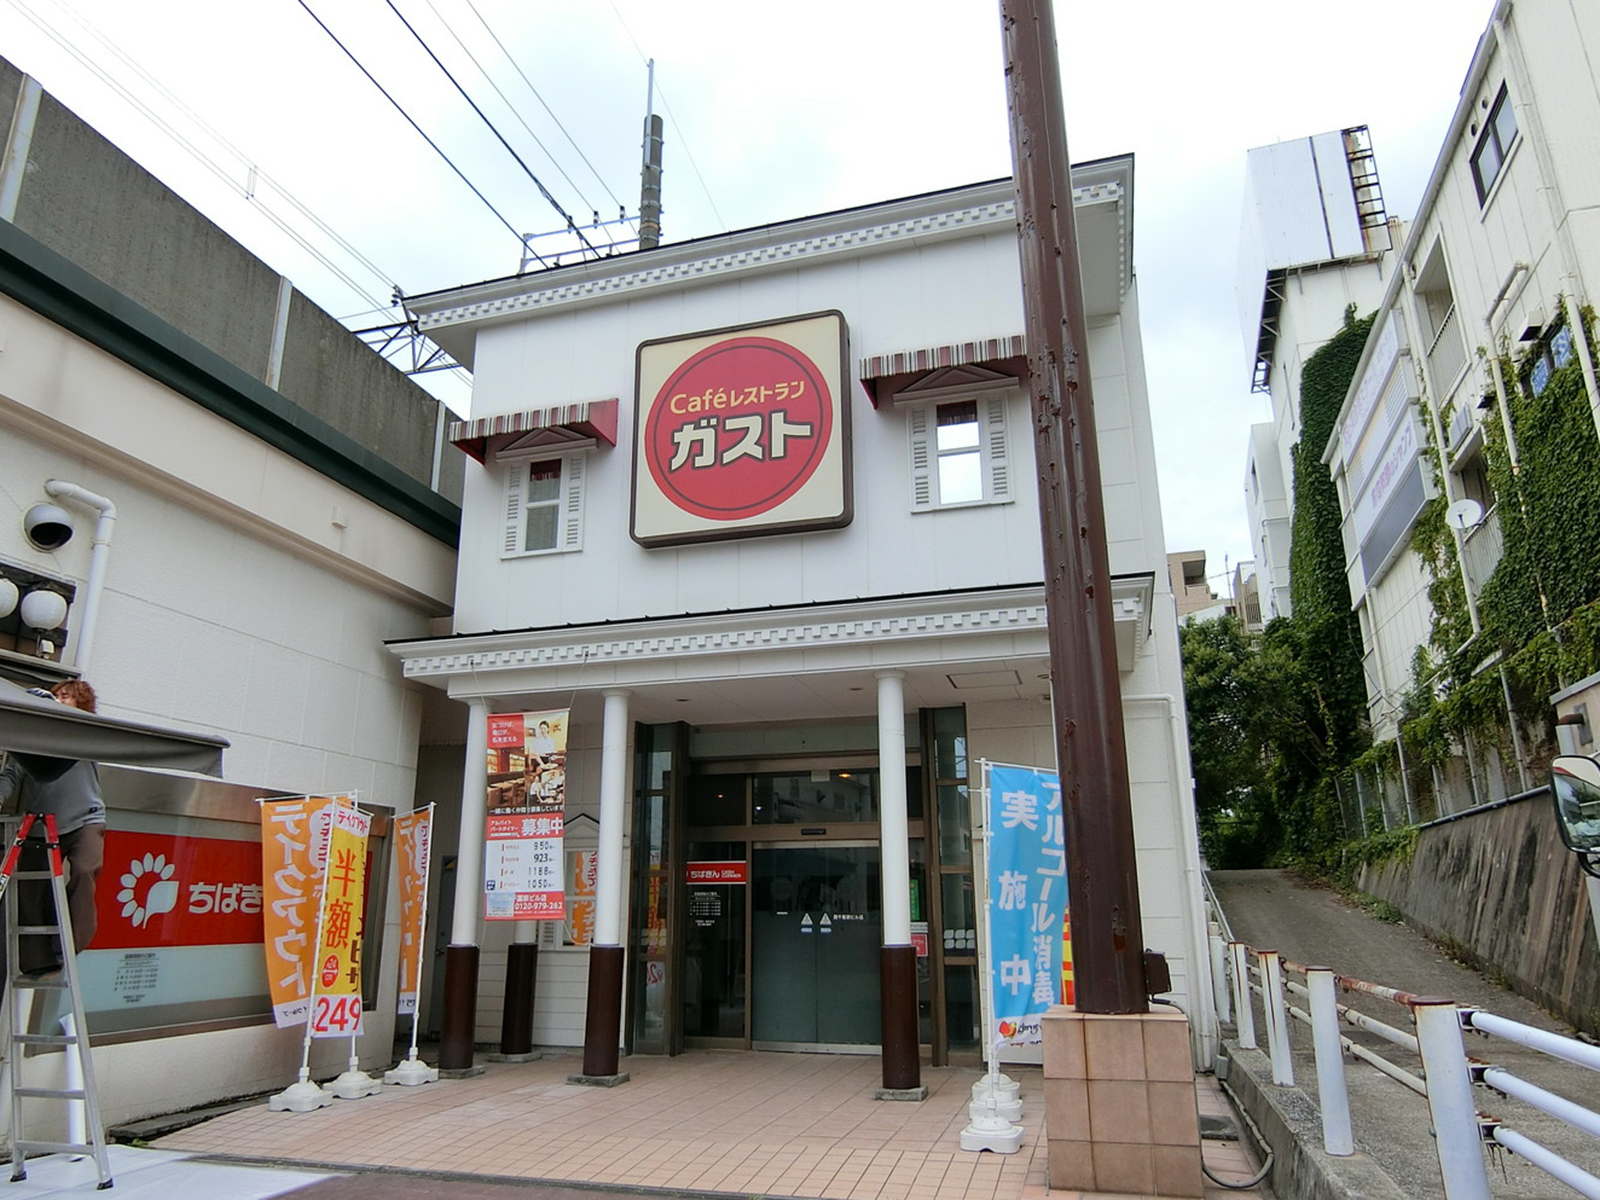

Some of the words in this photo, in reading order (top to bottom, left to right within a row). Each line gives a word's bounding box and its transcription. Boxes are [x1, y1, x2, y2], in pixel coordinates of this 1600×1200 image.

[668, 411, 811, 473] ガスト
[522, 817, 563, 837] 募集中
[326, 848, 357, 949] 半額
[998, 789, 1040, 996] 実施中
[1031, 780, 1066, 1008] アルコール消毒
[315, 996, 361, 1033] 249
